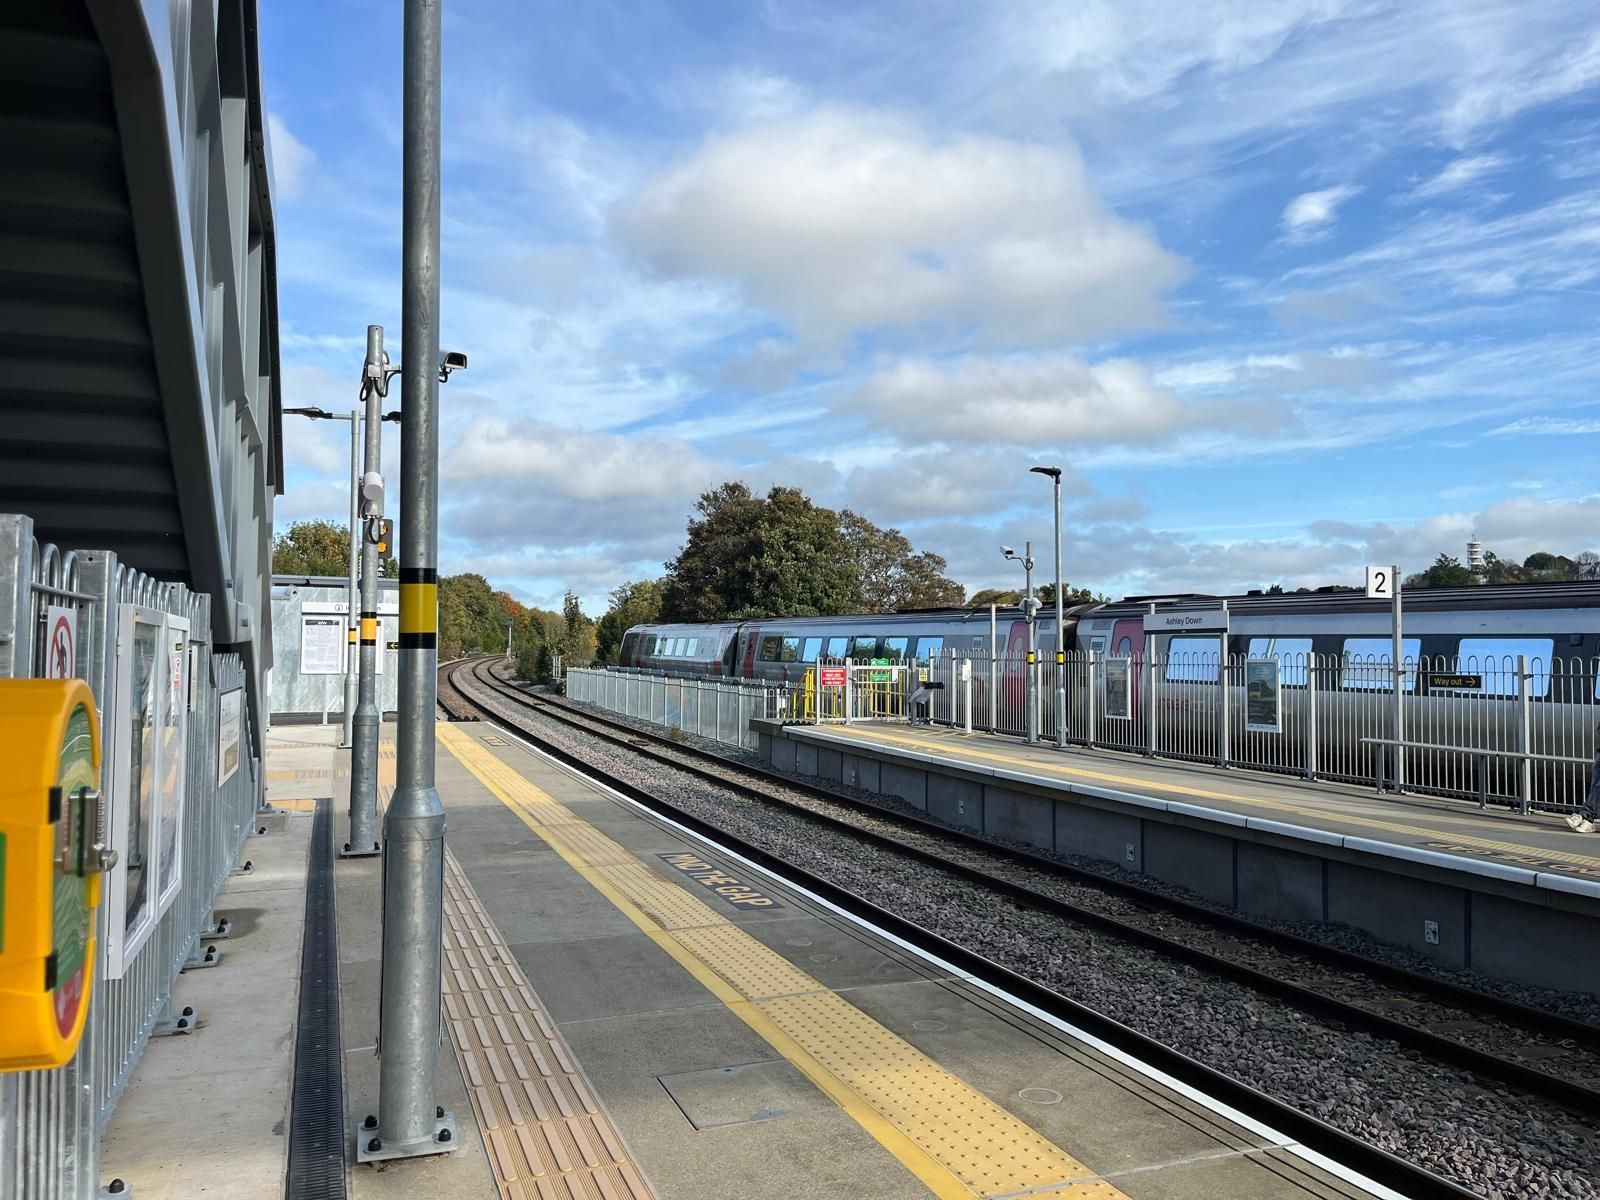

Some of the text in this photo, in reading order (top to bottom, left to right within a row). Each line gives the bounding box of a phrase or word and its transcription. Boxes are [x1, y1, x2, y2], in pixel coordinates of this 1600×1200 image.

[1374, 571, 1386, 593] 2
[1166, 616, 1203, 626] Ashley Down
[1434, 677, 1463, 686] Way out
[688, 869, 741, 886] THE
[714, 885, 774, 906] GAP
